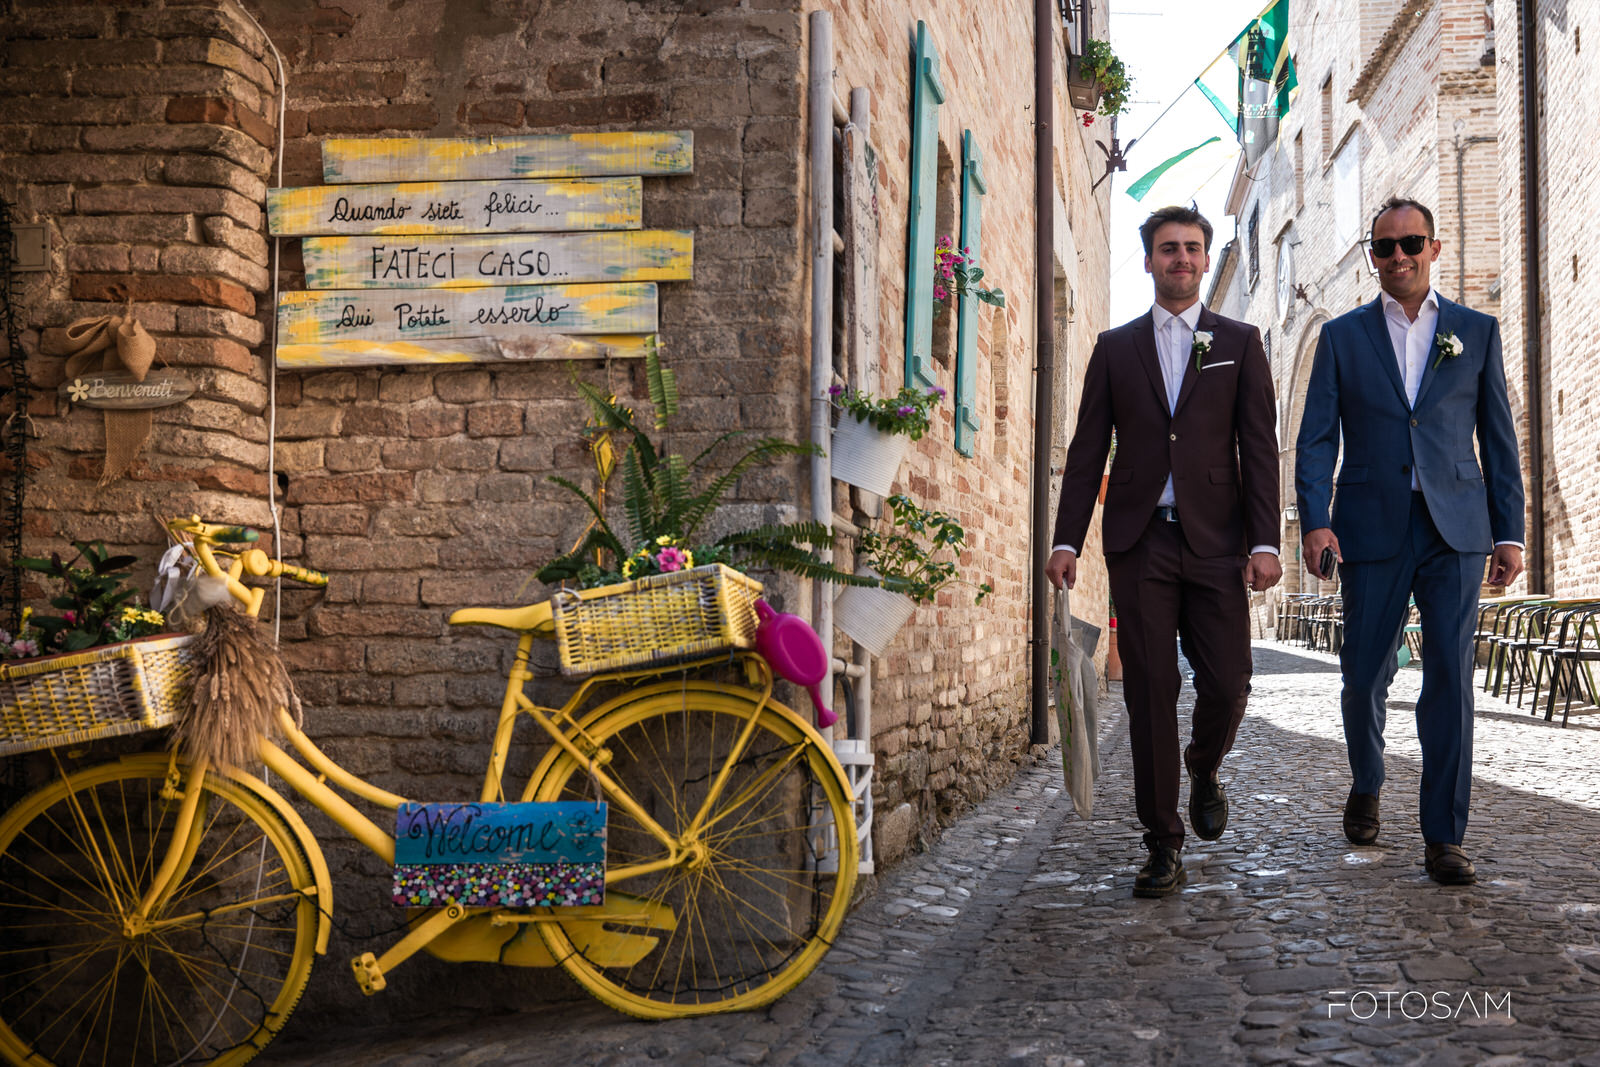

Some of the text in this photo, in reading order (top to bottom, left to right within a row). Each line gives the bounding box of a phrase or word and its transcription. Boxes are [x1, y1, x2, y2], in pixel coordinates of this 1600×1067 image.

[328, 197, 411, 222] Quando
[421, 200, 464, 221] siete
[372, 244, 456, 279] FATECI
[336, 296, 570, 330] Qui Potete esserlo
[92, 378, 174, 399] Benvenuti
[407, 804, 562, 858] Welcome
